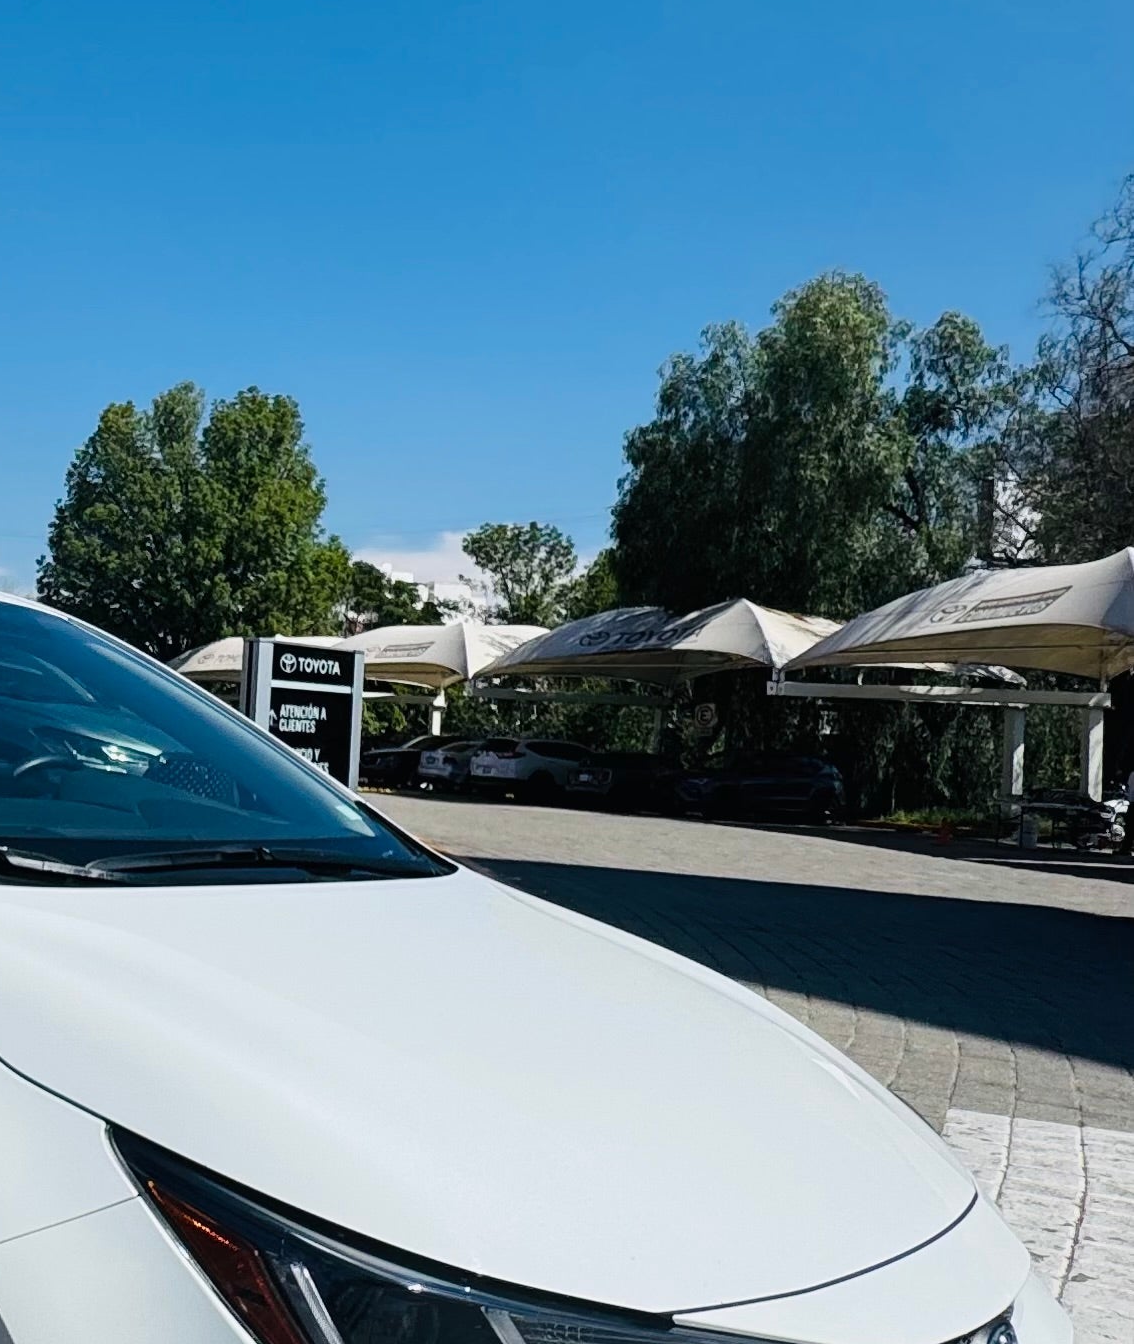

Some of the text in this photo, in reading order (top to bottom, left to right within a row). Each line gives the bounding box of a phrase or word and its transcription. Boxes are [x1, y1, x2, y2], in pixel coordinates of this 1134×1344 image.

[298, 657, 341, 675] TOYOTA
[280, 702, 327, 720] ATENCIÓN A
[279, 719, 316, 733] CLIENTES
